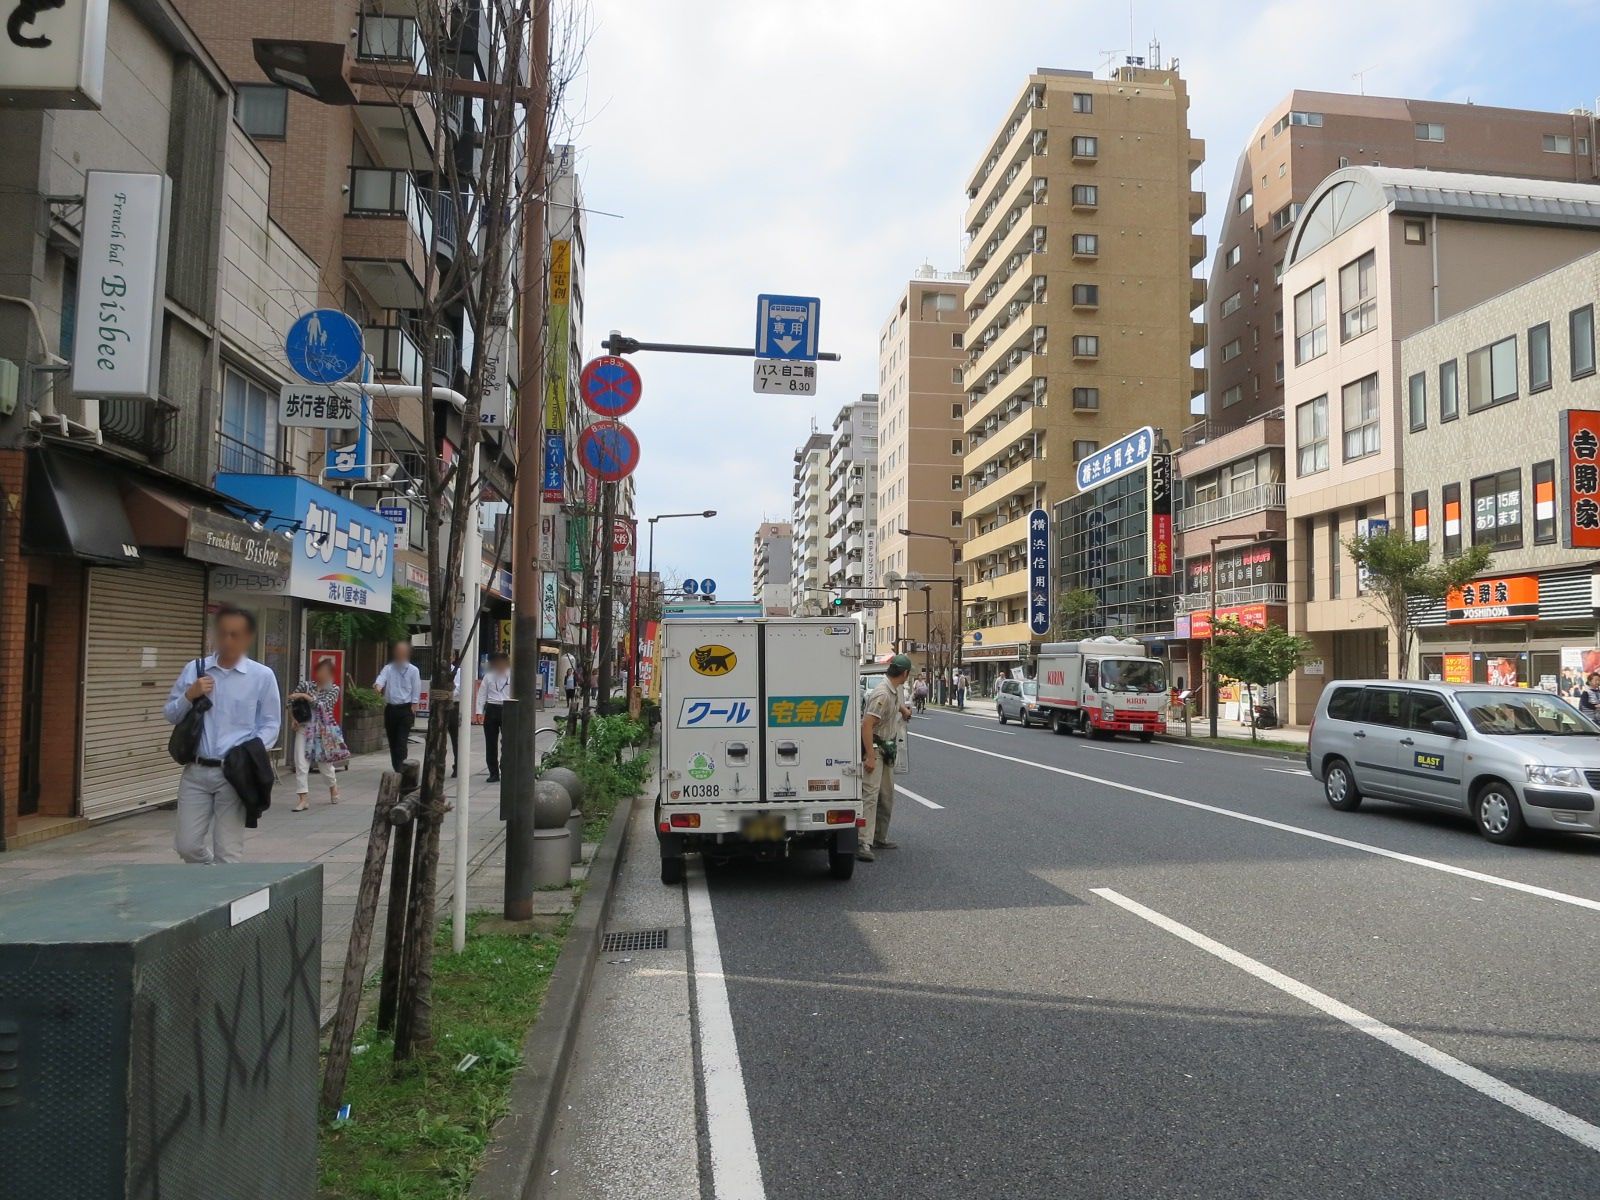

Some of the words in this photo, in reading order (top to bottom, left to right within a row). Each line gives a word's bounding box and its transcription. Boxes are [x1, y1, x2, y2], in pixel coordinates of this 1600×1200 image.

[97, 276, 131, 371] Bisbee
[773, 322, 803, 336] 専用
[286, 393, 353, 420] 歩行者優先
[1082, 434, 1148, 484] 横浜信用金庫
[1153, 455, 1164, 501] アイアン
[1572, 429, 1600, 529] 吉野家
[121, 543, 140, 559] BAR
[244, 538, 279, 567] Bisbee
[304, 500, 389, 579] クリーニング
[1031, 518, 1047, 625] 横浜信用金庫
[1463, 582, 1507, 606] 吉野家
[1048, 671, 1064, 685] KIRIN
[687, 702, 751, 725] クール
[771, 699, 844, 724] 宅急便
[1126, 697, 1147, 705] KIRIN
[1417, 755, 1440, 766] BLAST
